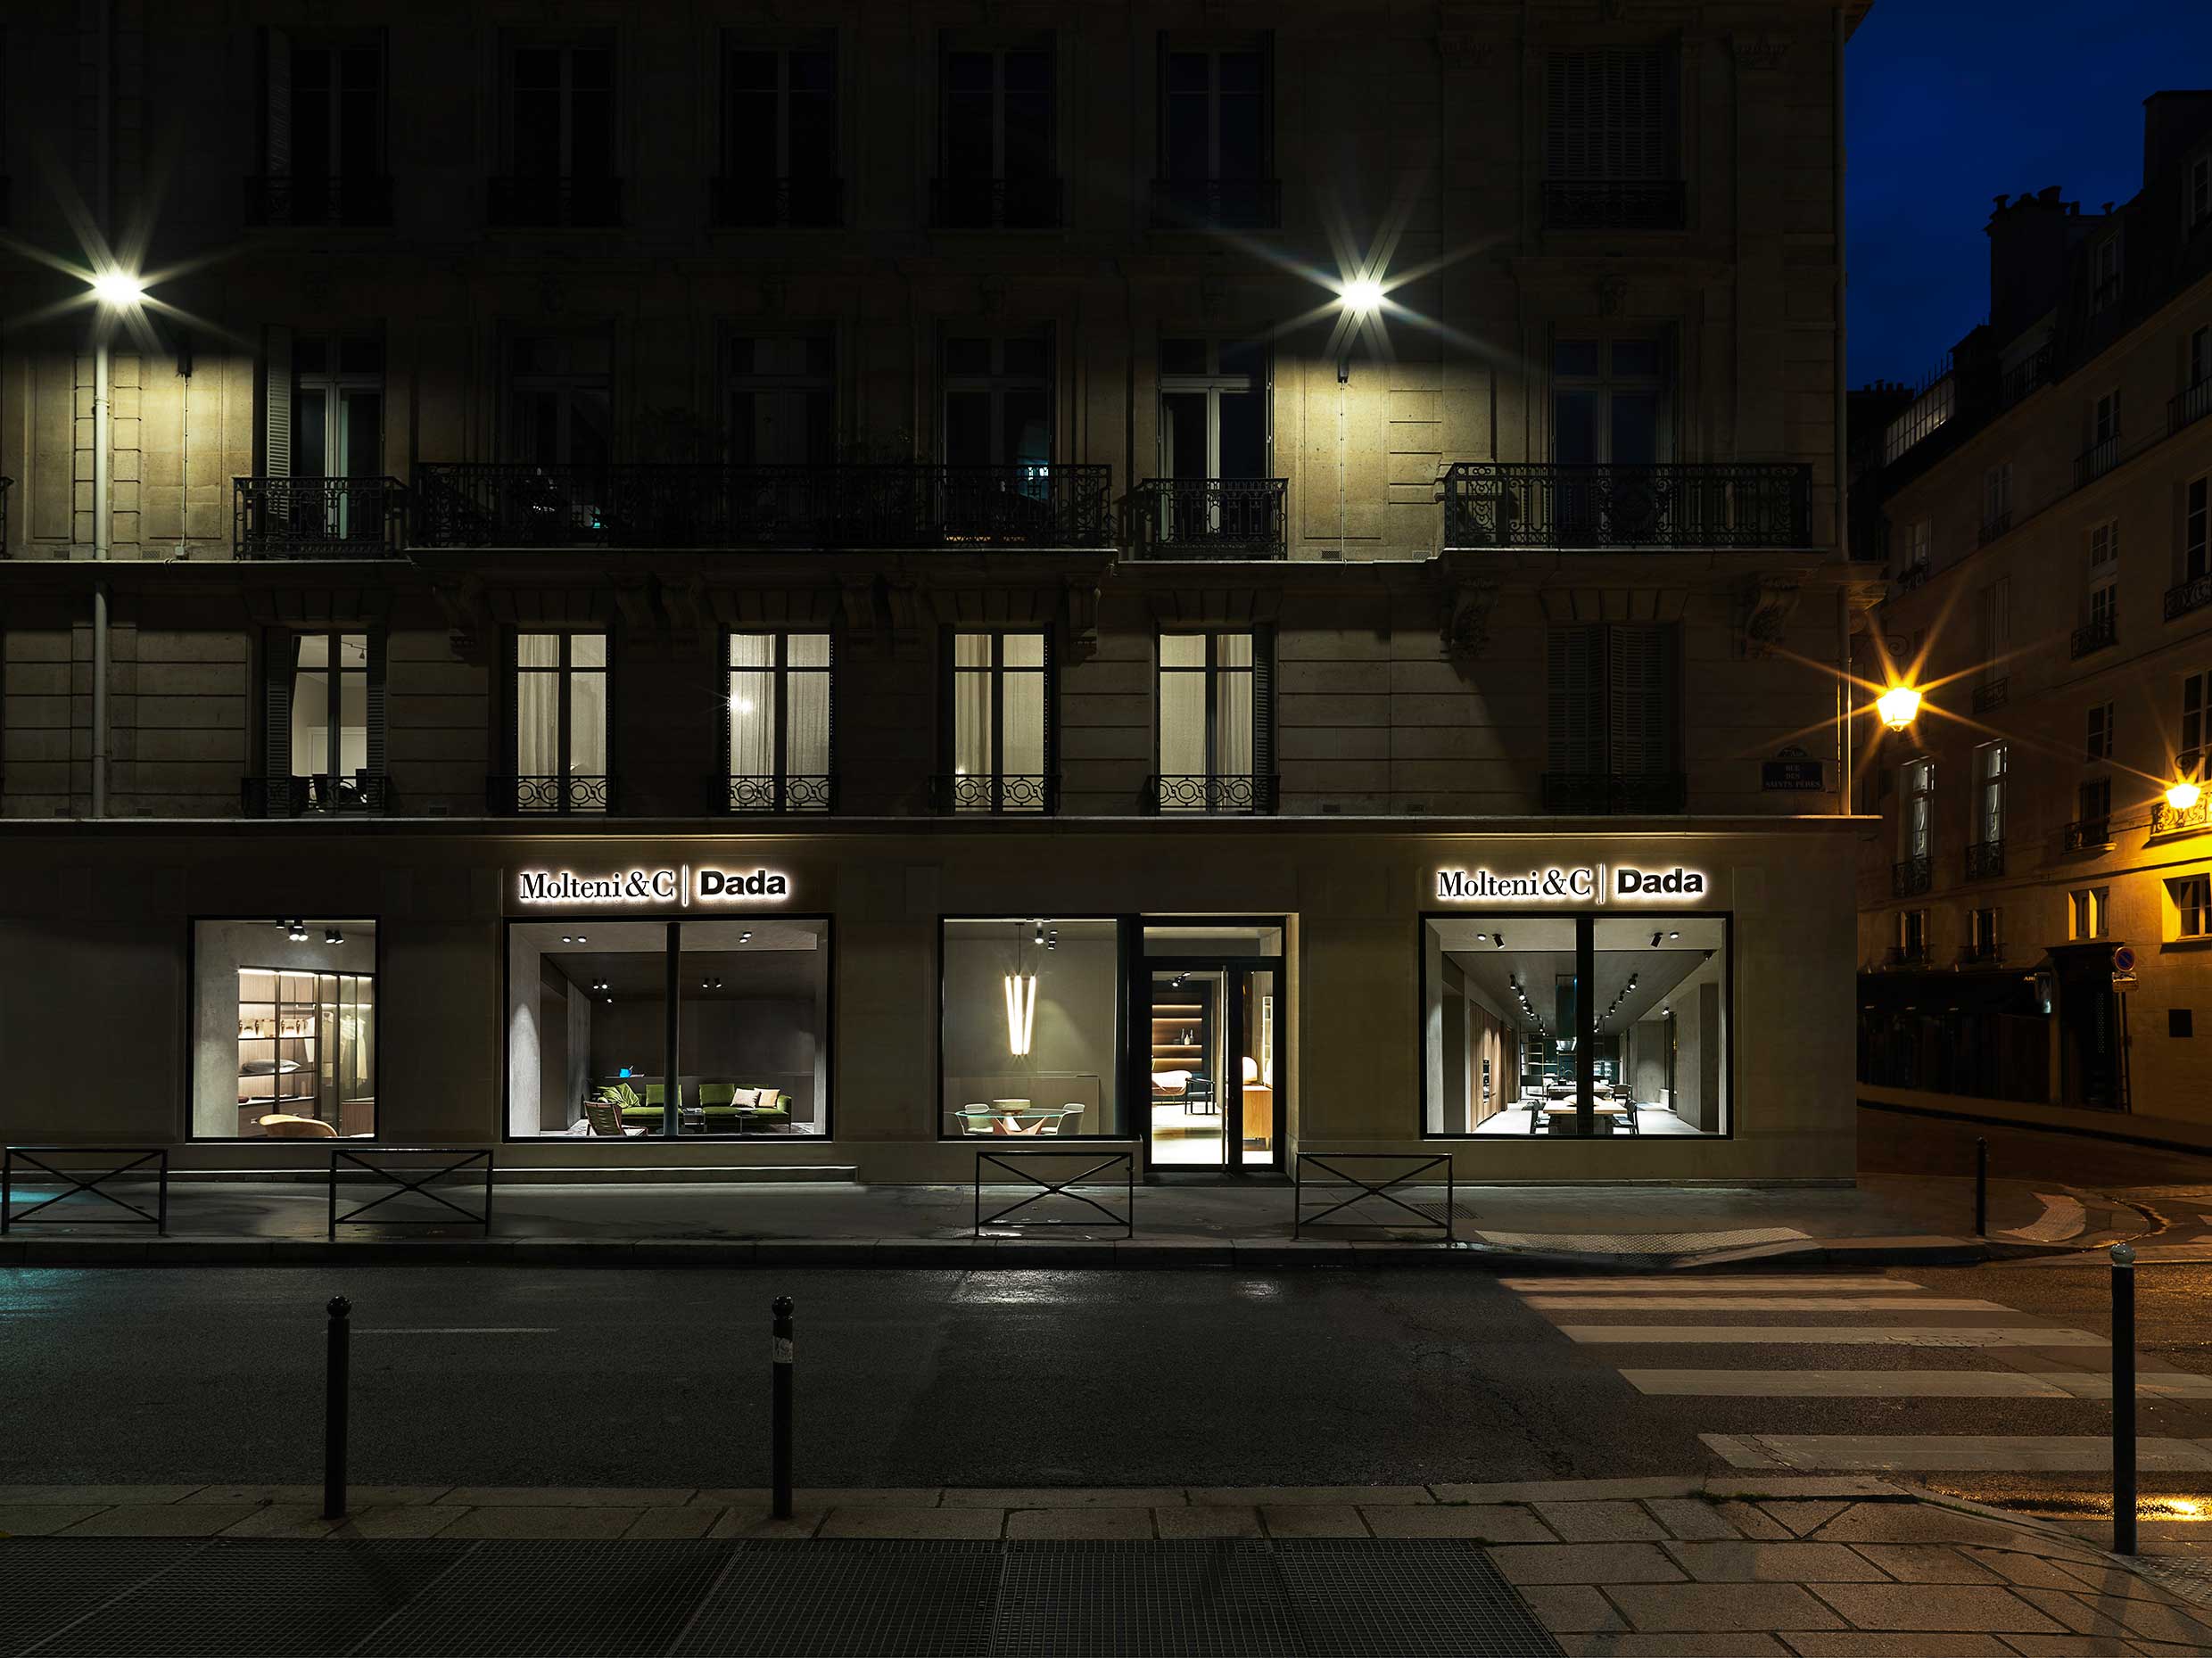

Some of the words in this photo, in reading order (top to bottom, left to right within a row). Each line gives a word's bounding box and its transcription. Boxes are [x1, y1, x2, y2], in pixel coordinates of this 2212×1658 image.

[520, 870, 673, 899] Molteni&C
[701, 870, 786, 895] Dada
[1438, 869, 1590, 897] Molteni&C
[1618, 868, 1703, 894] Dada
